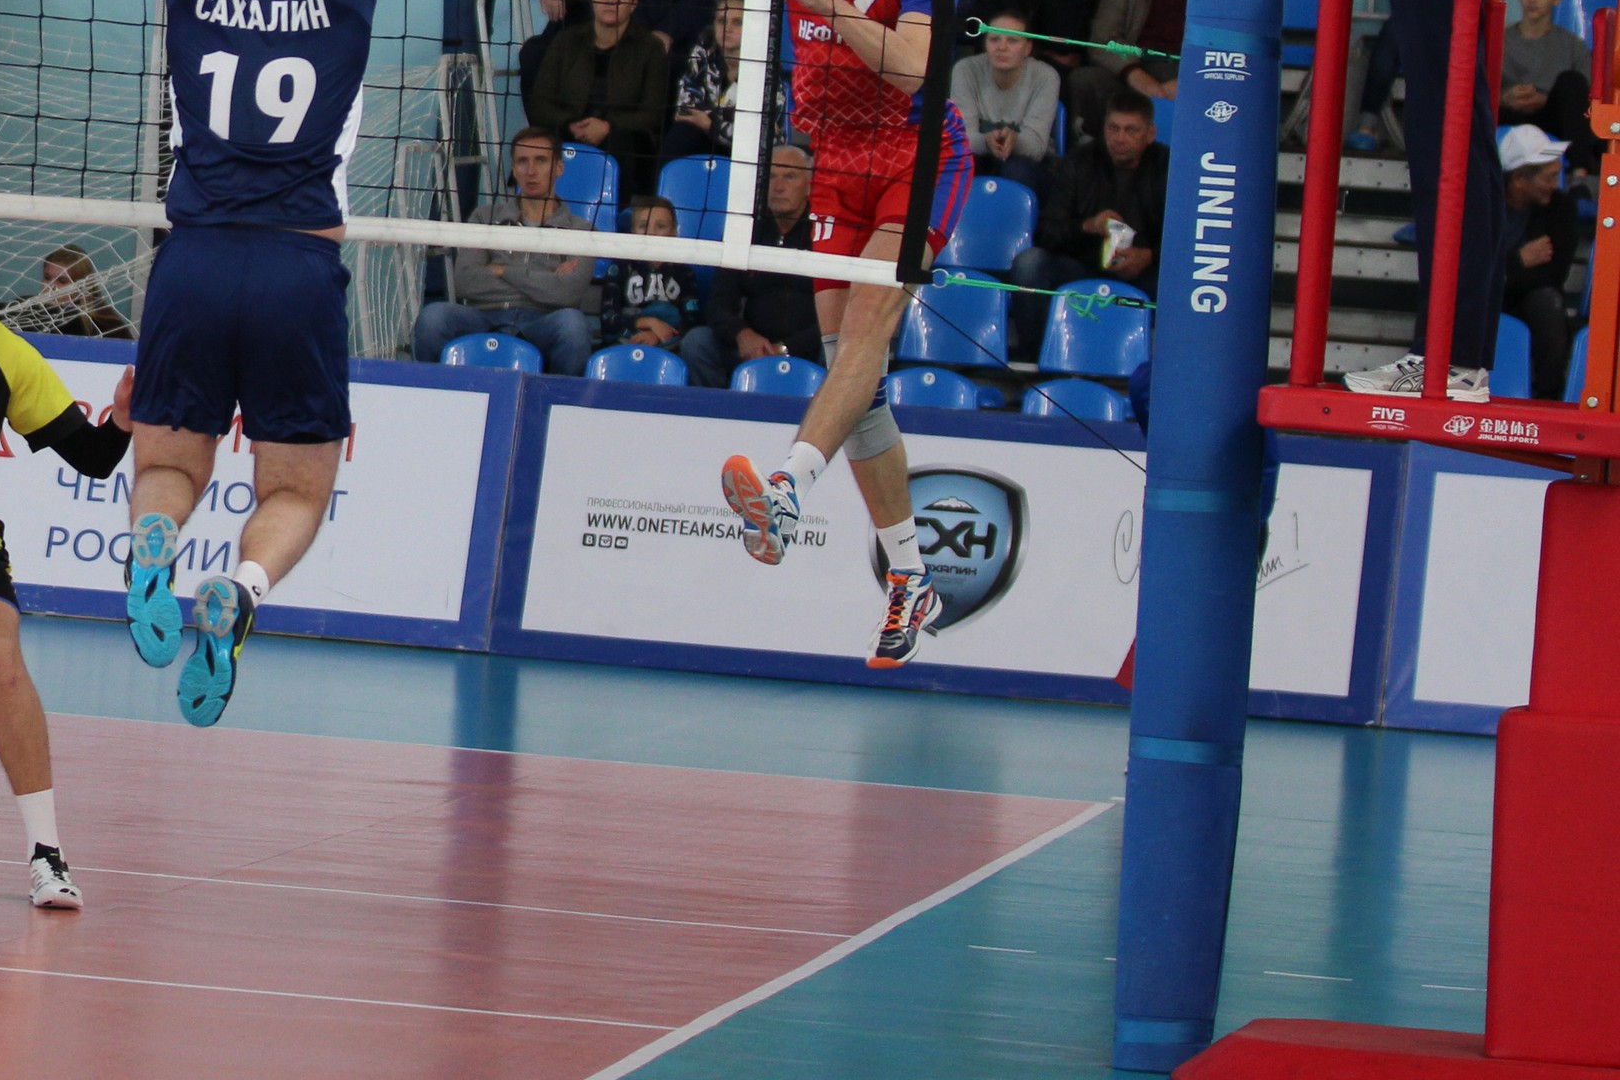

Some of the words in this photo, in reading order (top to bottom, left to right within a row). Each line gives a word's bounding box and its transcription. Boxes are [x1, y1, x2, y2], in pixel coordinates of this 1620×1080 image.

[1204, 51, 1247, 68] FIVB
[199, 50, 317, 144] 19
[1190, 152, 1237, 313] JINLING
[1372, 407, 1406, 421] FIVB
[1479, 418, 1539, 438] 金陵体育
[1477, 434, 1508, 442] JINLING
[1508, 436, 1540, 445] SPORTS
[57, 467, 348, 521] ЧЕМИОТ
[587, 497, 686, 514] ПРОФЕССИОНАЛЬНЫЙ
[688, 505, 742, 518] СПОРТИВН
[587, 512, 827, 547] WWW.ONETEAMSAKN.RU
[45, 526, 231, 574] РОСИИ
